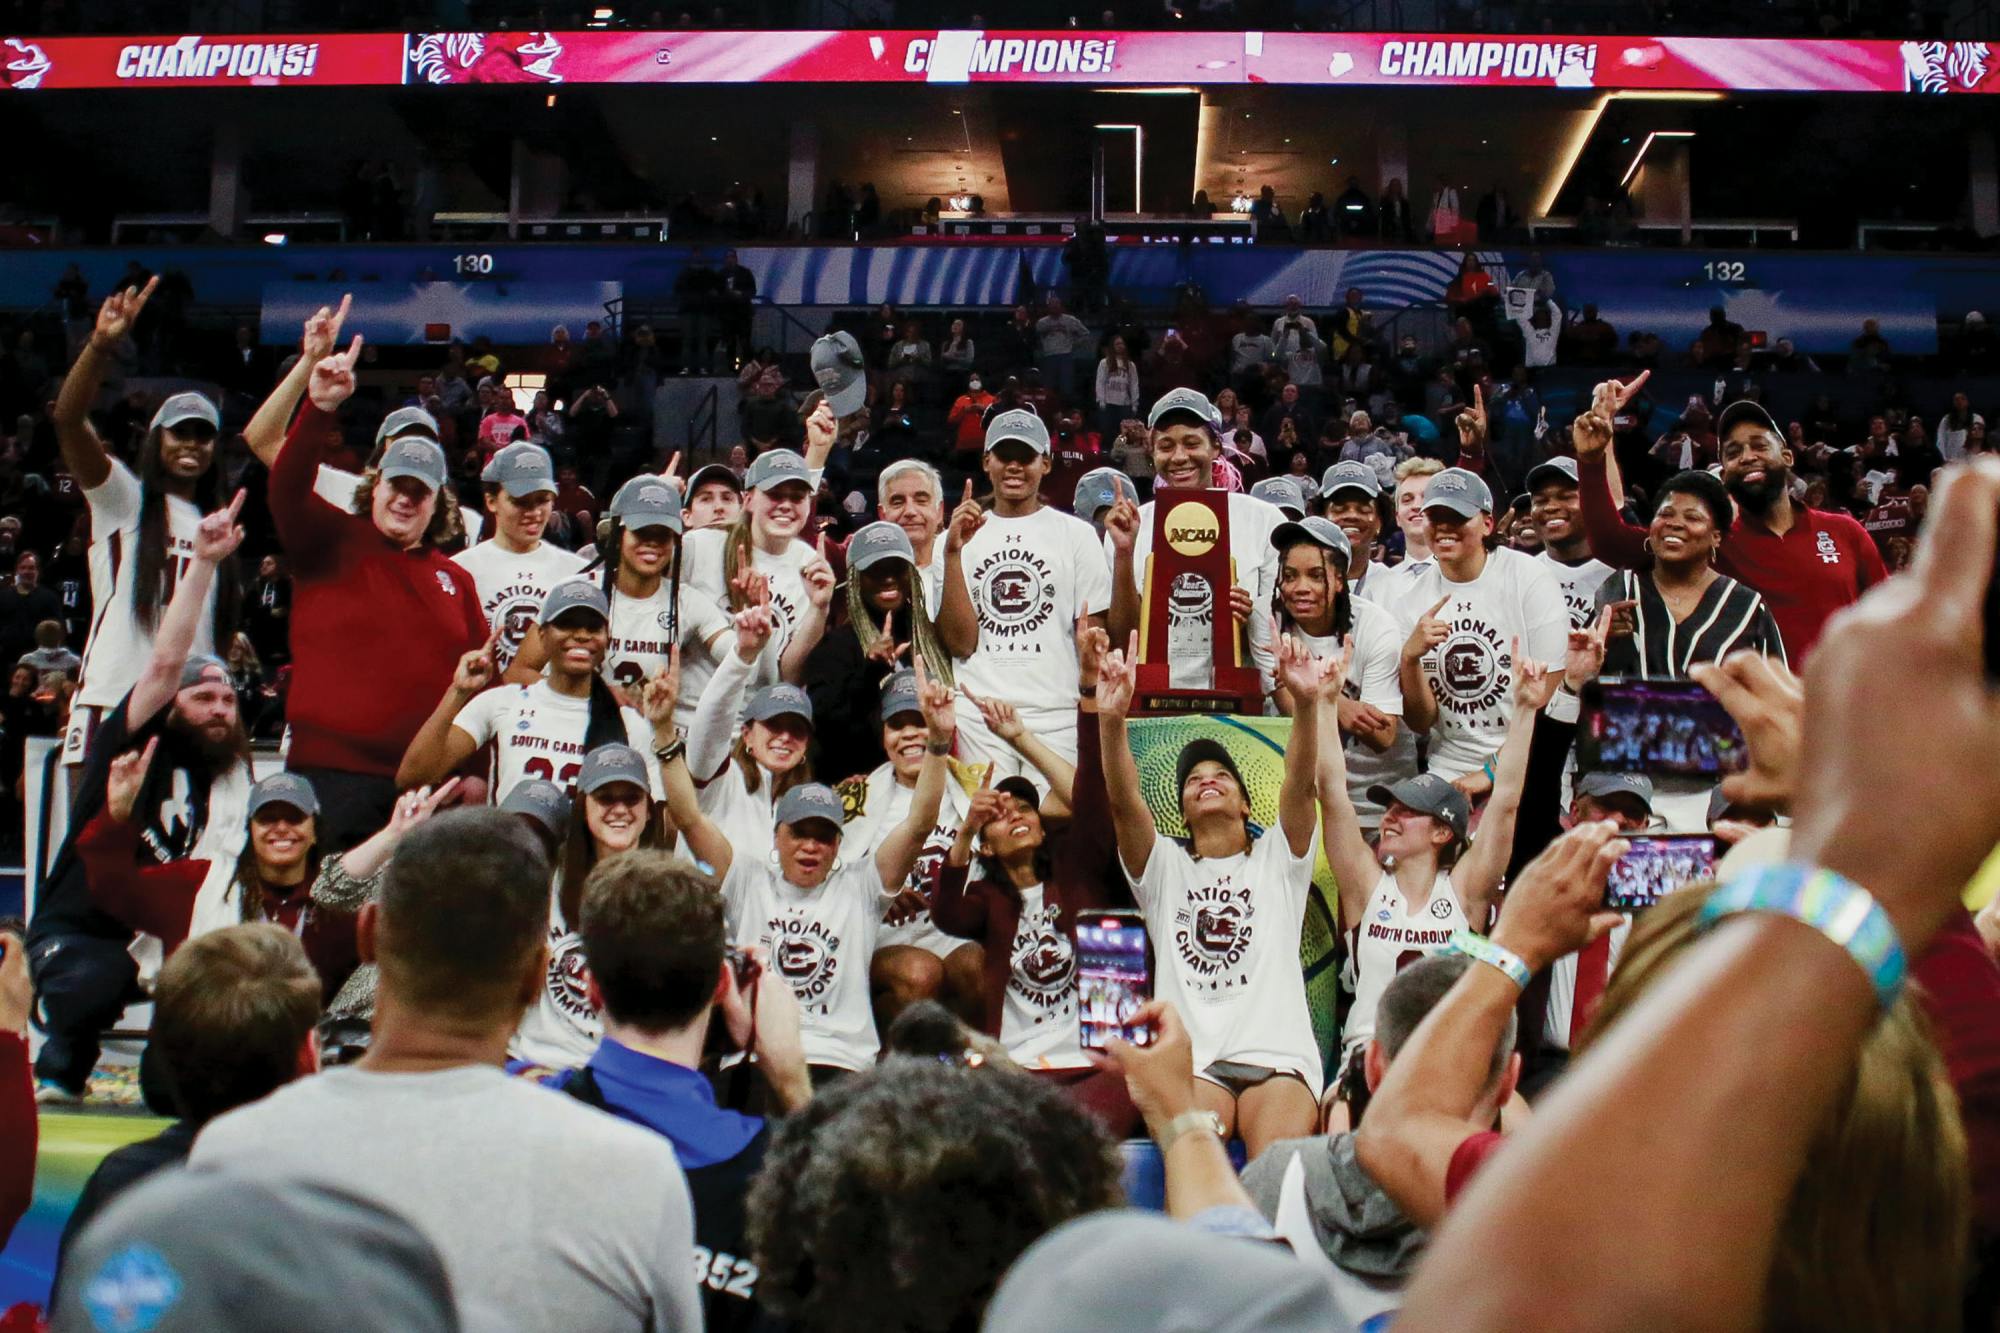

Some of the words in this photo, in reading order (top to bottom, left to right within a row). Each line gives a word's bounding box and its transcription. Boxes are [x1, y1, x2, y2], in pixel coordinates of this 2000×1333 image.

[116, 43, 319, 78] CHAMPIONS!
[904, 39, 1116, 73] CMPIONS!
[1379, 41, 1597, 78] CHAMPIONS!
[453, 254, 493, 273] 130
[1703, 261, 1745, 281] 132
[1169, 527, 1218, 545] NCAA
[973, 549, 1051, 580] NATIONAL
[484, 585, 547, 612] NATION
[1429, 674, 1511, 715] CHAMPIONS
[511, 735, 549, 749] SOUTH
[553, 740, 587, 755] CARO
[1367, 923, 1402, 942] SOUTH
[1405, 929, 1453, 944] CAROLIN
